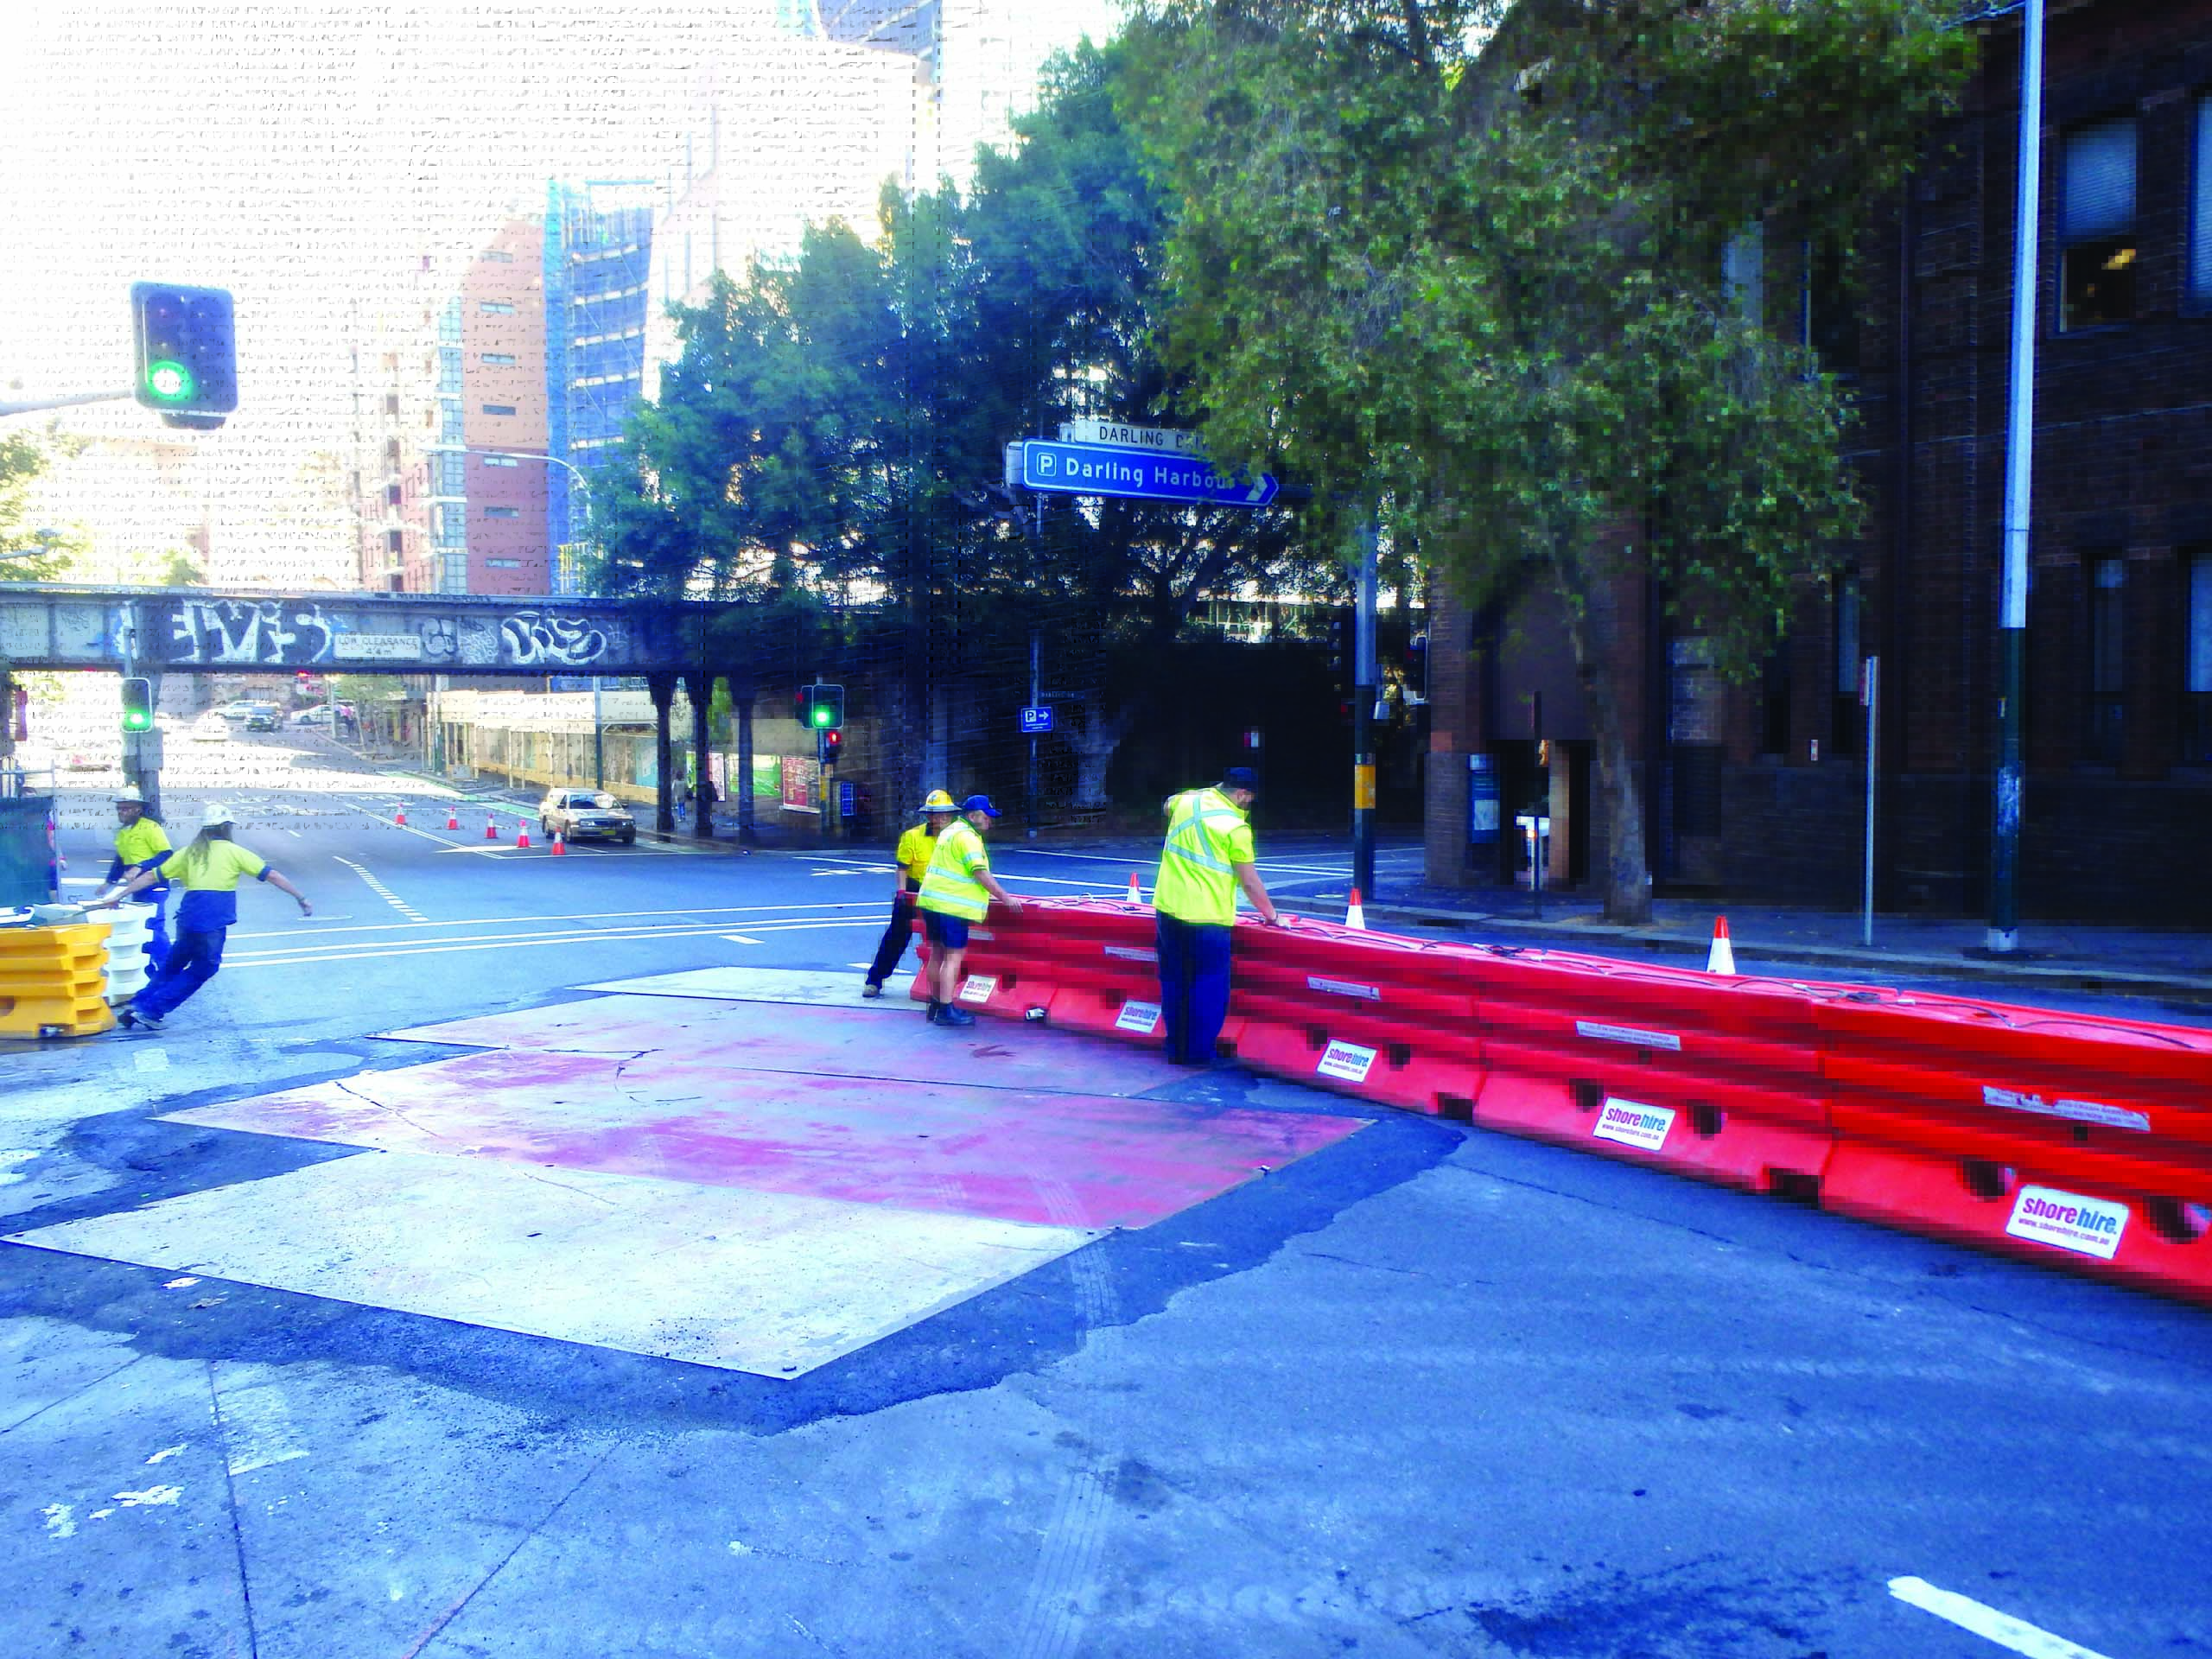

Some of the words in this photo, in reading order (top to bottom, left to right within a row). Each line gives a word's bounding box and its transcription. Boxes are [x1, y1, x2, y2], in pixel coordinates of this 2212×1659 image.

[1099, 426, 1164, 446] DARLING
[1039, 454, 1053, 474] P
[1066, 457, 1143, 488] Darling
[362, 636, 417, 646] CLEARANCE
